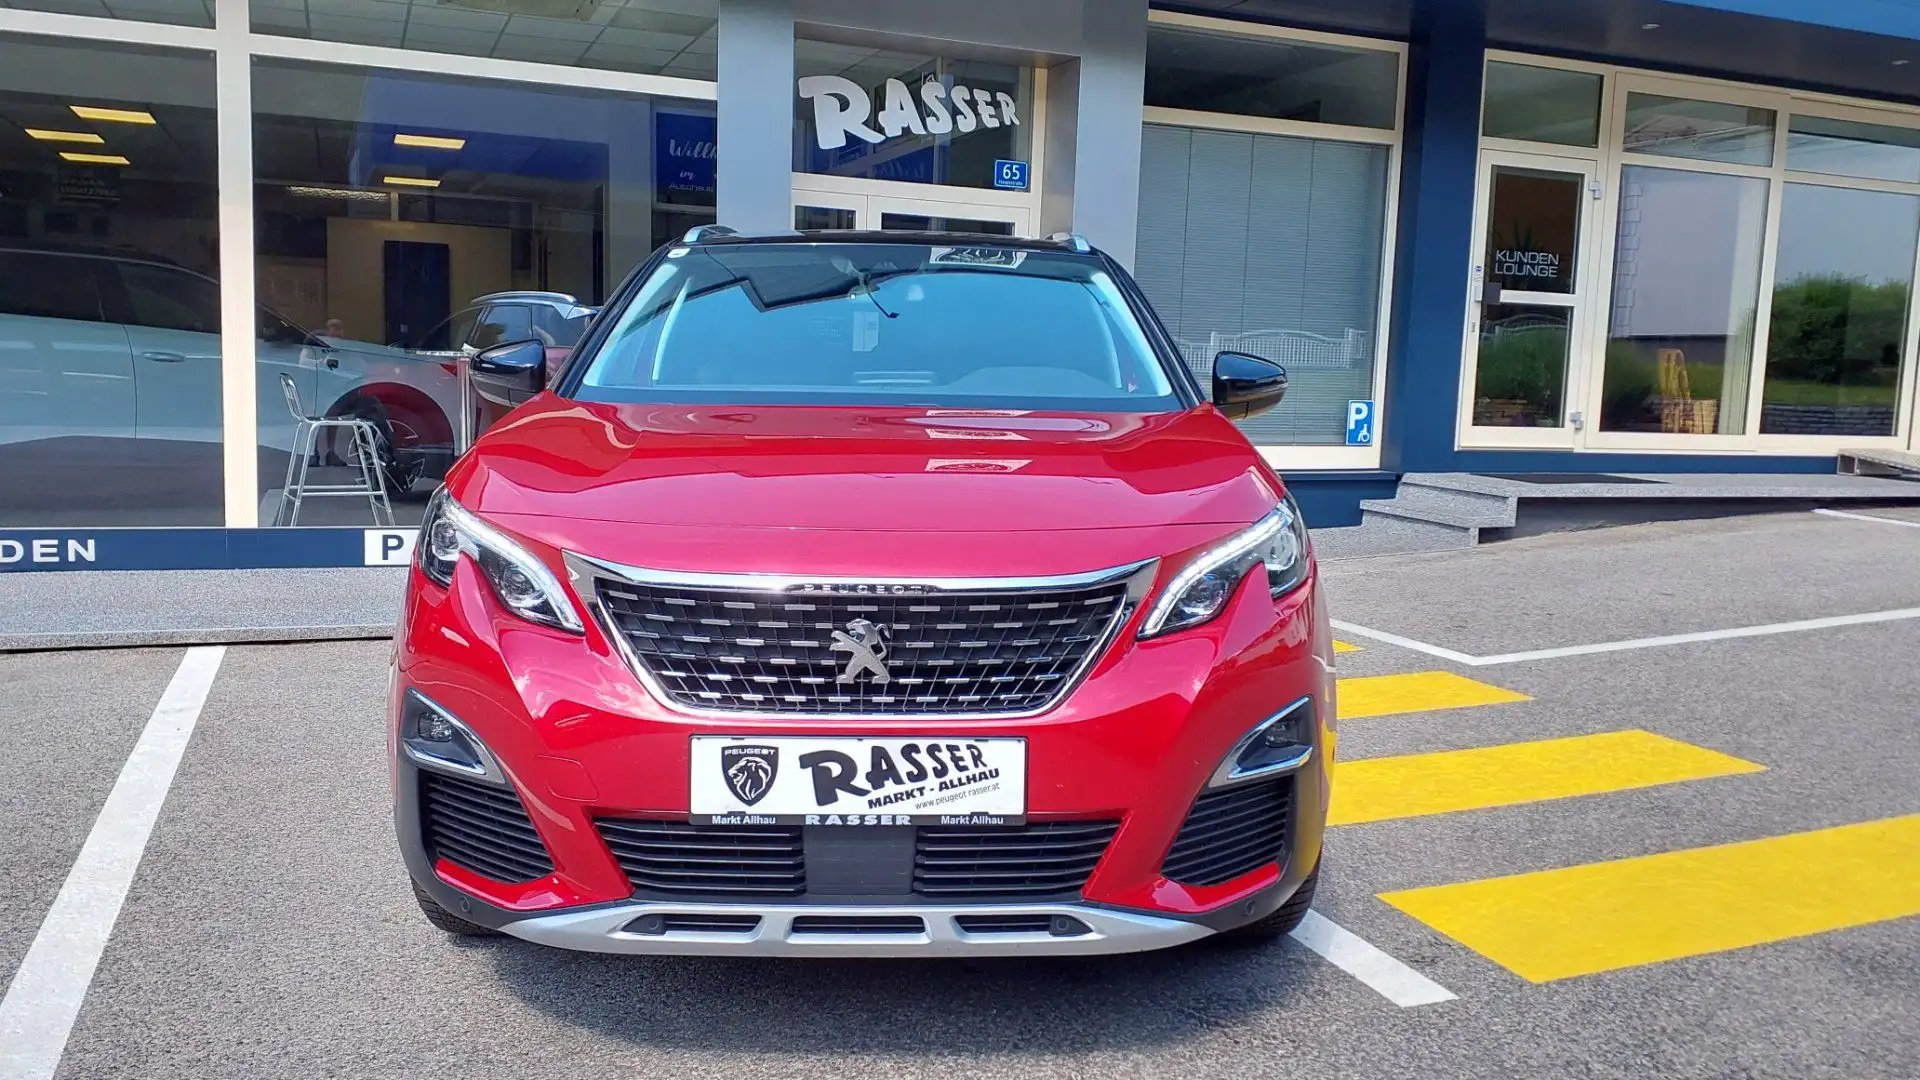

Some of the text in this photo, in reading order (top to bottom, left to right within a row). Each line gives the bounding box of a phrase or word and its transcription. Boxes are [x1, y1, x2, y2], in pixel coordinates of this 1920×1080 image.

[798, 76, 1019, 149] RASSER
[1003, 164, 1020, 179] 65
[1496, 250, 1559, 264] KUNDEN
[1495, 263, 1558, 277] LOUNGE
[1350, 402, 1368, 429] P
[382, 534, 404, 560] P
[804, 584, 922, 594] PEUGEOT
[725, 748, 775, 756] PEUGEOT
[799, 743, 987, 806] RASSER
[867, 786, 926, 809] MARKT
[938, 767, 1000, 792] ALLHAU
[712, 815, 776, 825] Markt Allhau
[805, 814, 912, 826] RASSER
[941, 815, 1004, 825] Markt Allhau
